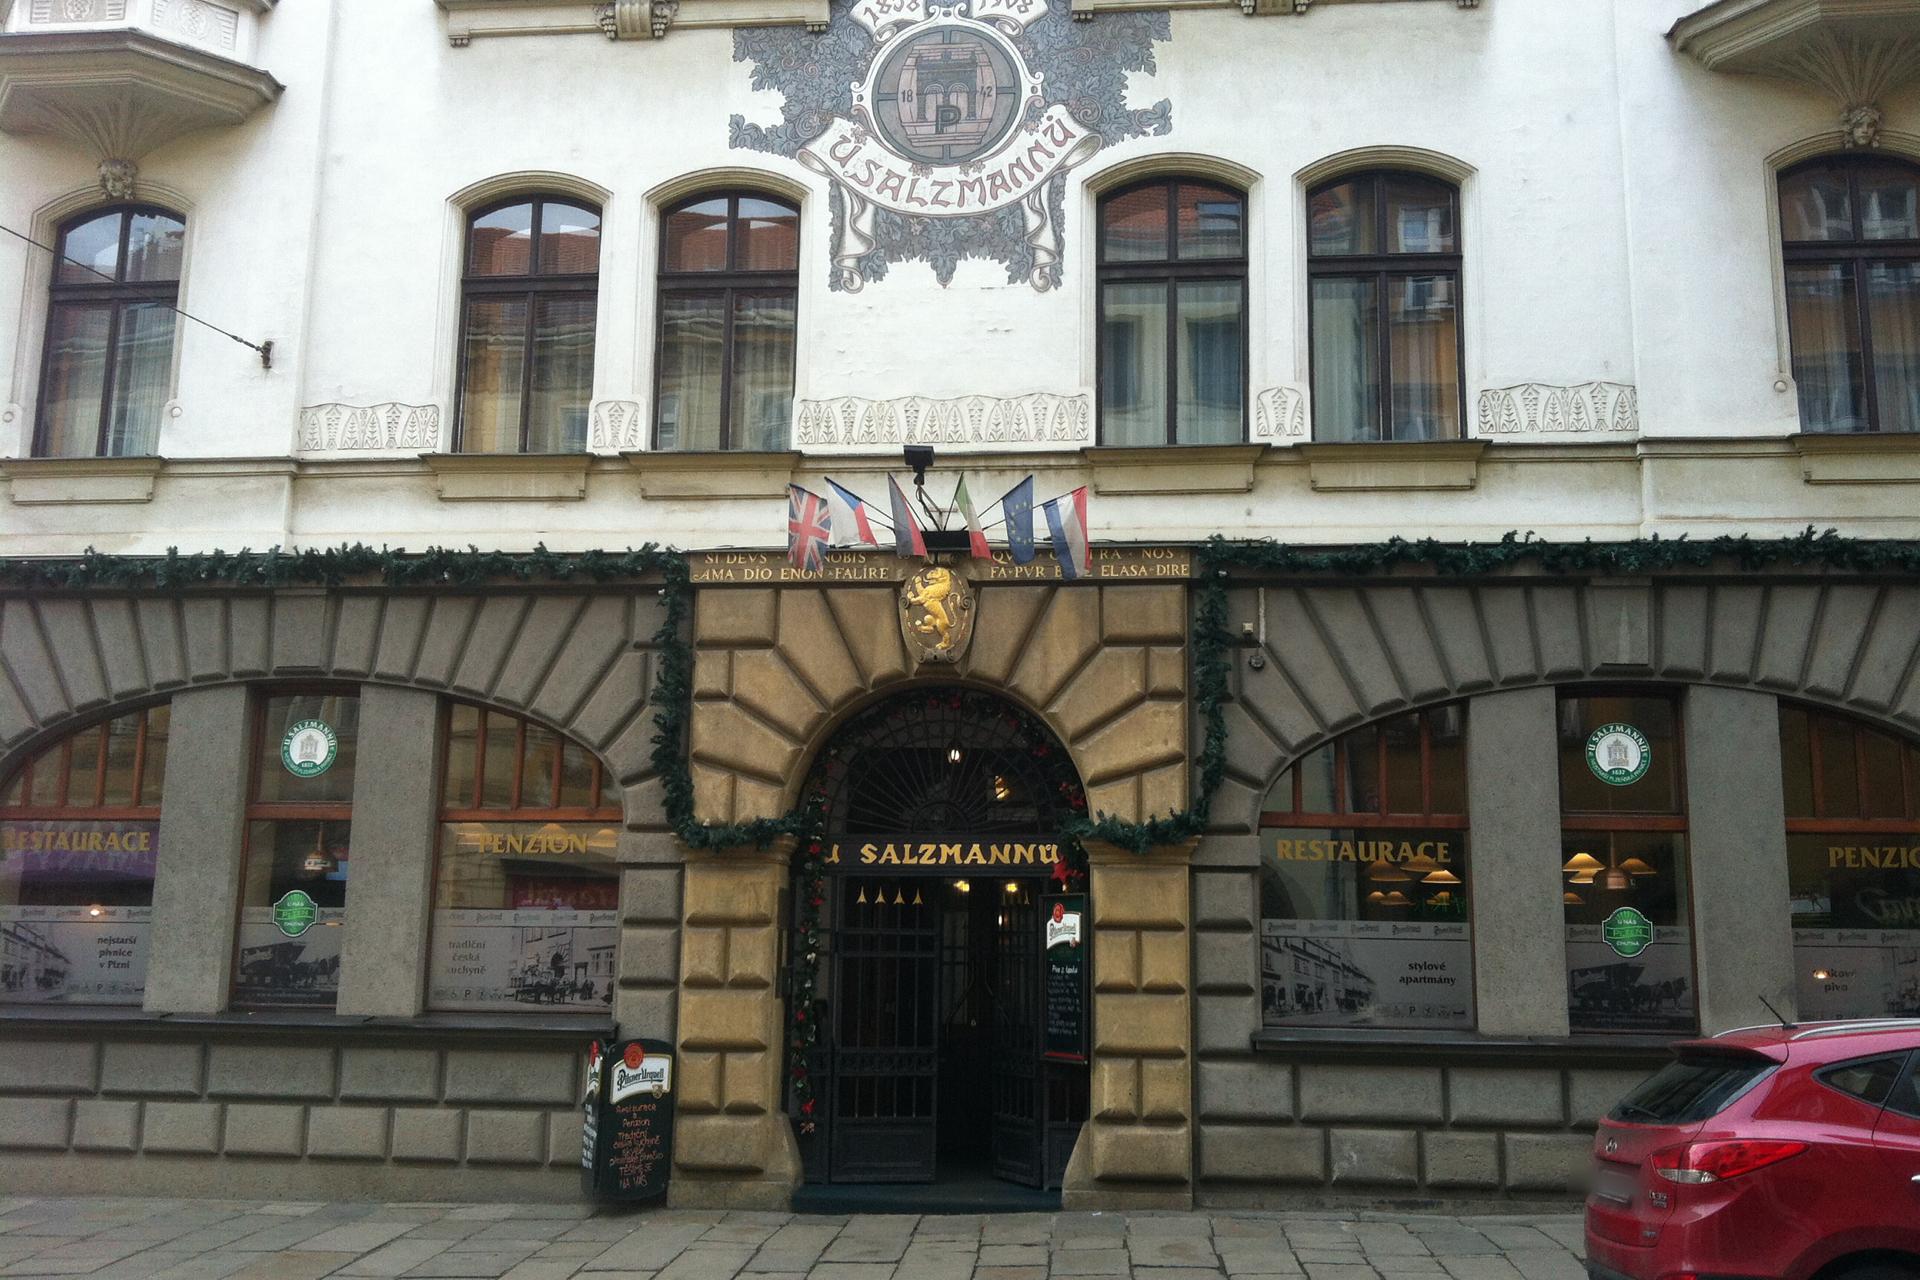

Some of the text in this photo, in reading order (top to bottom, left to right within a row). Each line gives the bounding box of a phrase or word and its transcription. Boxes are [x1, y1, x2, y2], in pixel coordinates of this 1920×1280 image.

[901, 89, 913, 103] 18
[705, 553, 719, 564] SI
[1142, 548, 1174, 559] NOS
[693, 568, 735, 581] AMA
[990, 566, 1007, 579] FA
[1101, 565, 1148, 577] ELASA
[1156, 563, 1190, 577] DIRE
[3, 830, 150, 852] RESTAURACE
[479, 832, 587, 855] PENZION
[860, 843, 1061, 865] SALZMANNŮ
[1276, 839, 1451, 863] RESTAURACE
[1408, 960, 1446, 974] stylové
[1399, 973, 1457, 987] apartmány
[617, 1068, 641, 1092] Pilsner
[641, 1067, 665, 1084] Urquell
